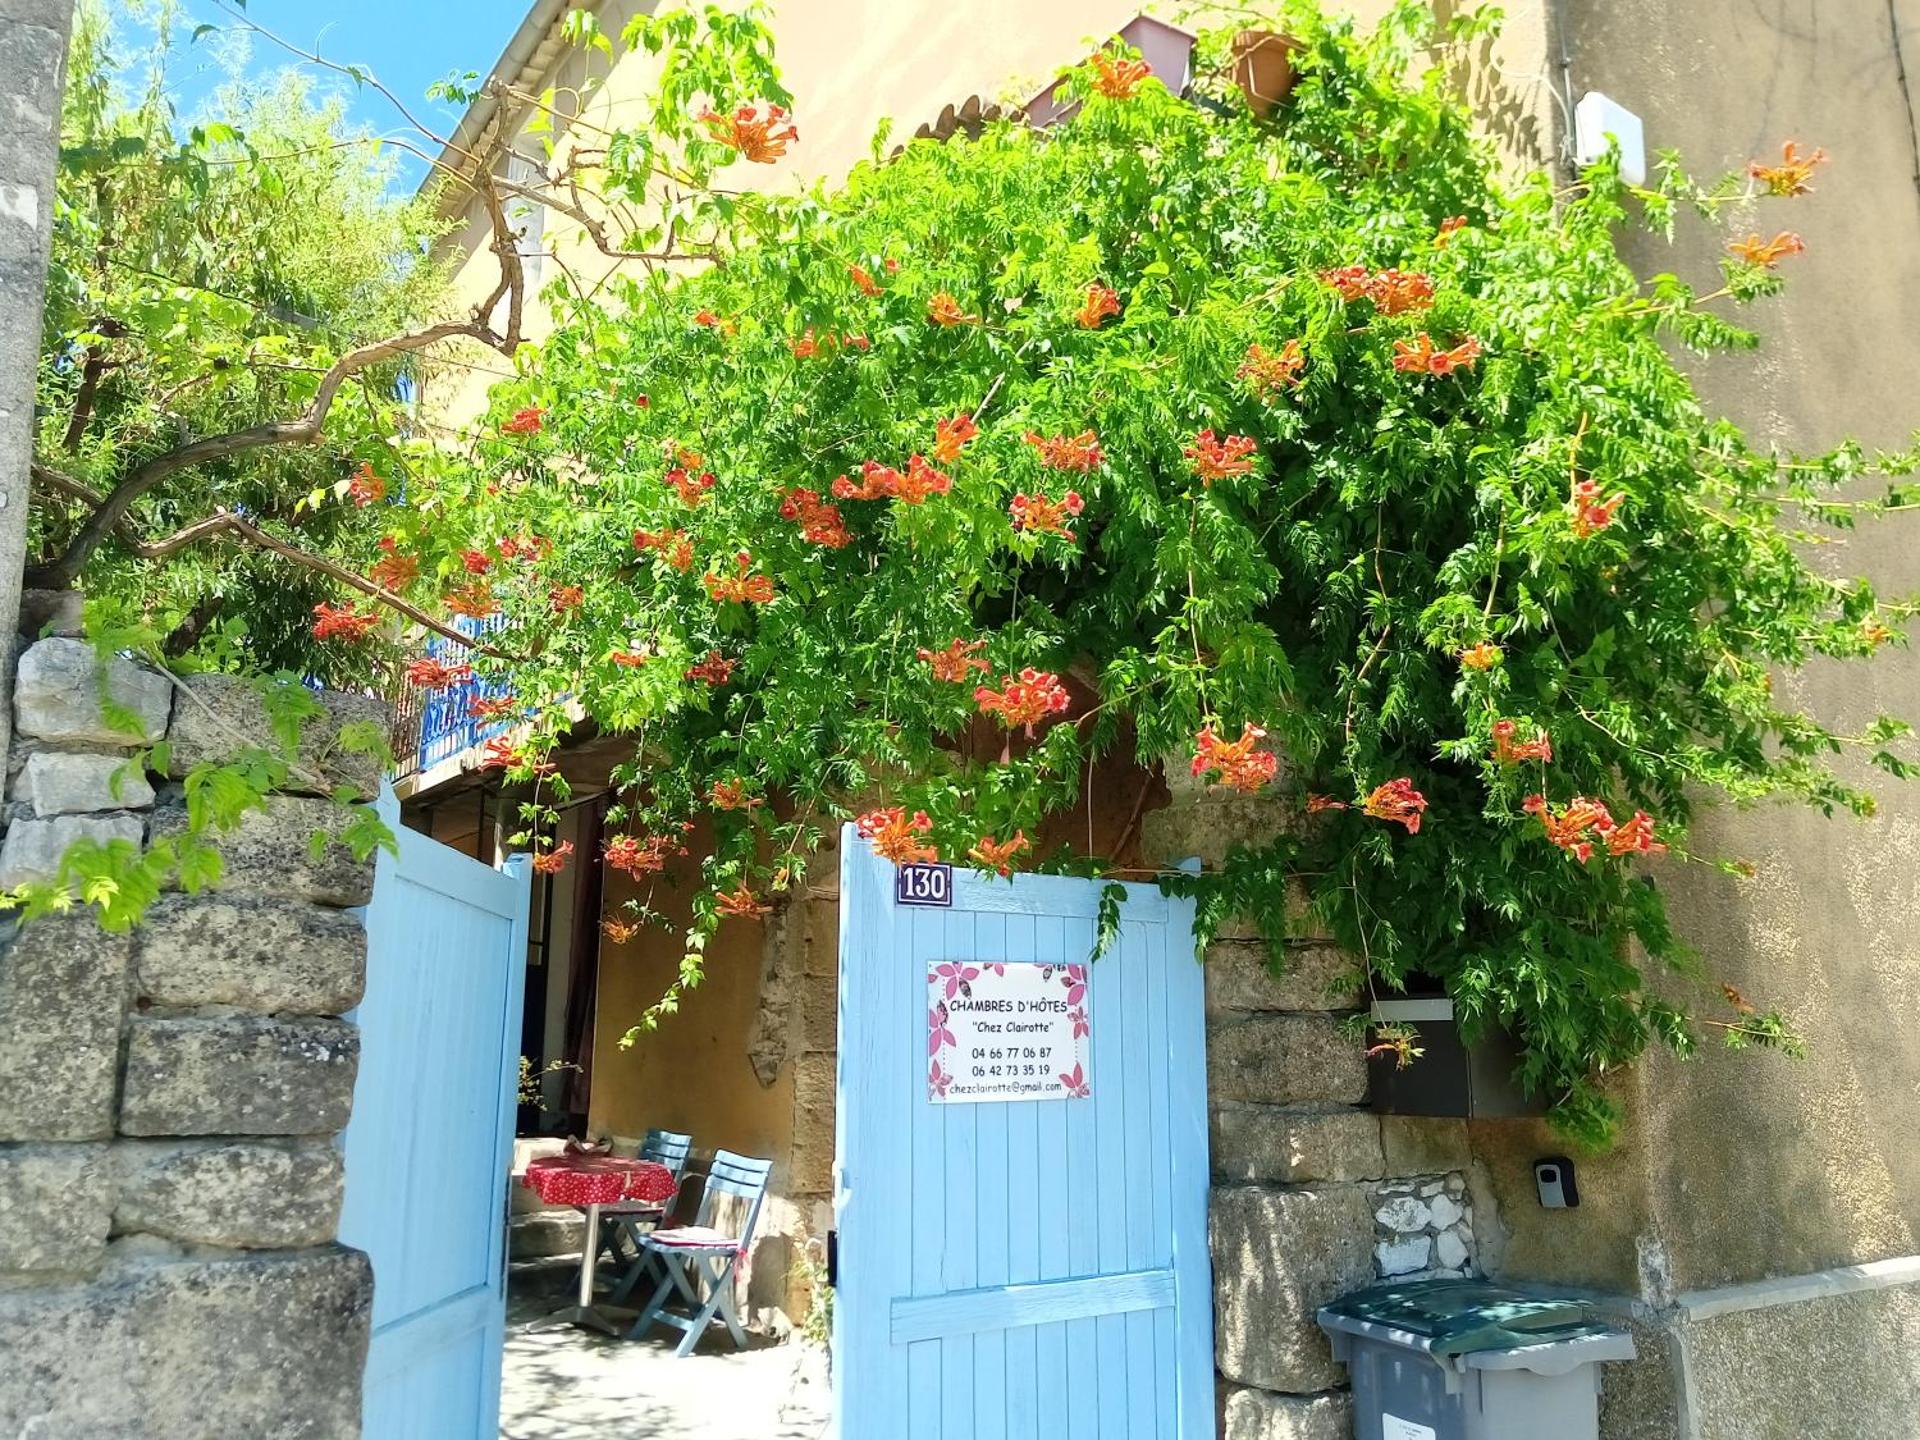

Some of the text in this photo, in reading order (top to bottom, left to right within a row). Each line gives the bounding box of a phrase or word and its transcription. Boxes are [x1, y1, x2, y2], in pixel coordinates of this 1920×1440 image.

[904, 867, 945, 899] 130
[950, 997, 1067, 1012] CHAMBRES D'HÔTES
[972, 1022, 1054, 1033] "Chez Clairotte"
[972, 1047, 1051, 1059] 04 66 77 06 87
[972, 1065, 1050, 1077] 06 42 73 35 19
